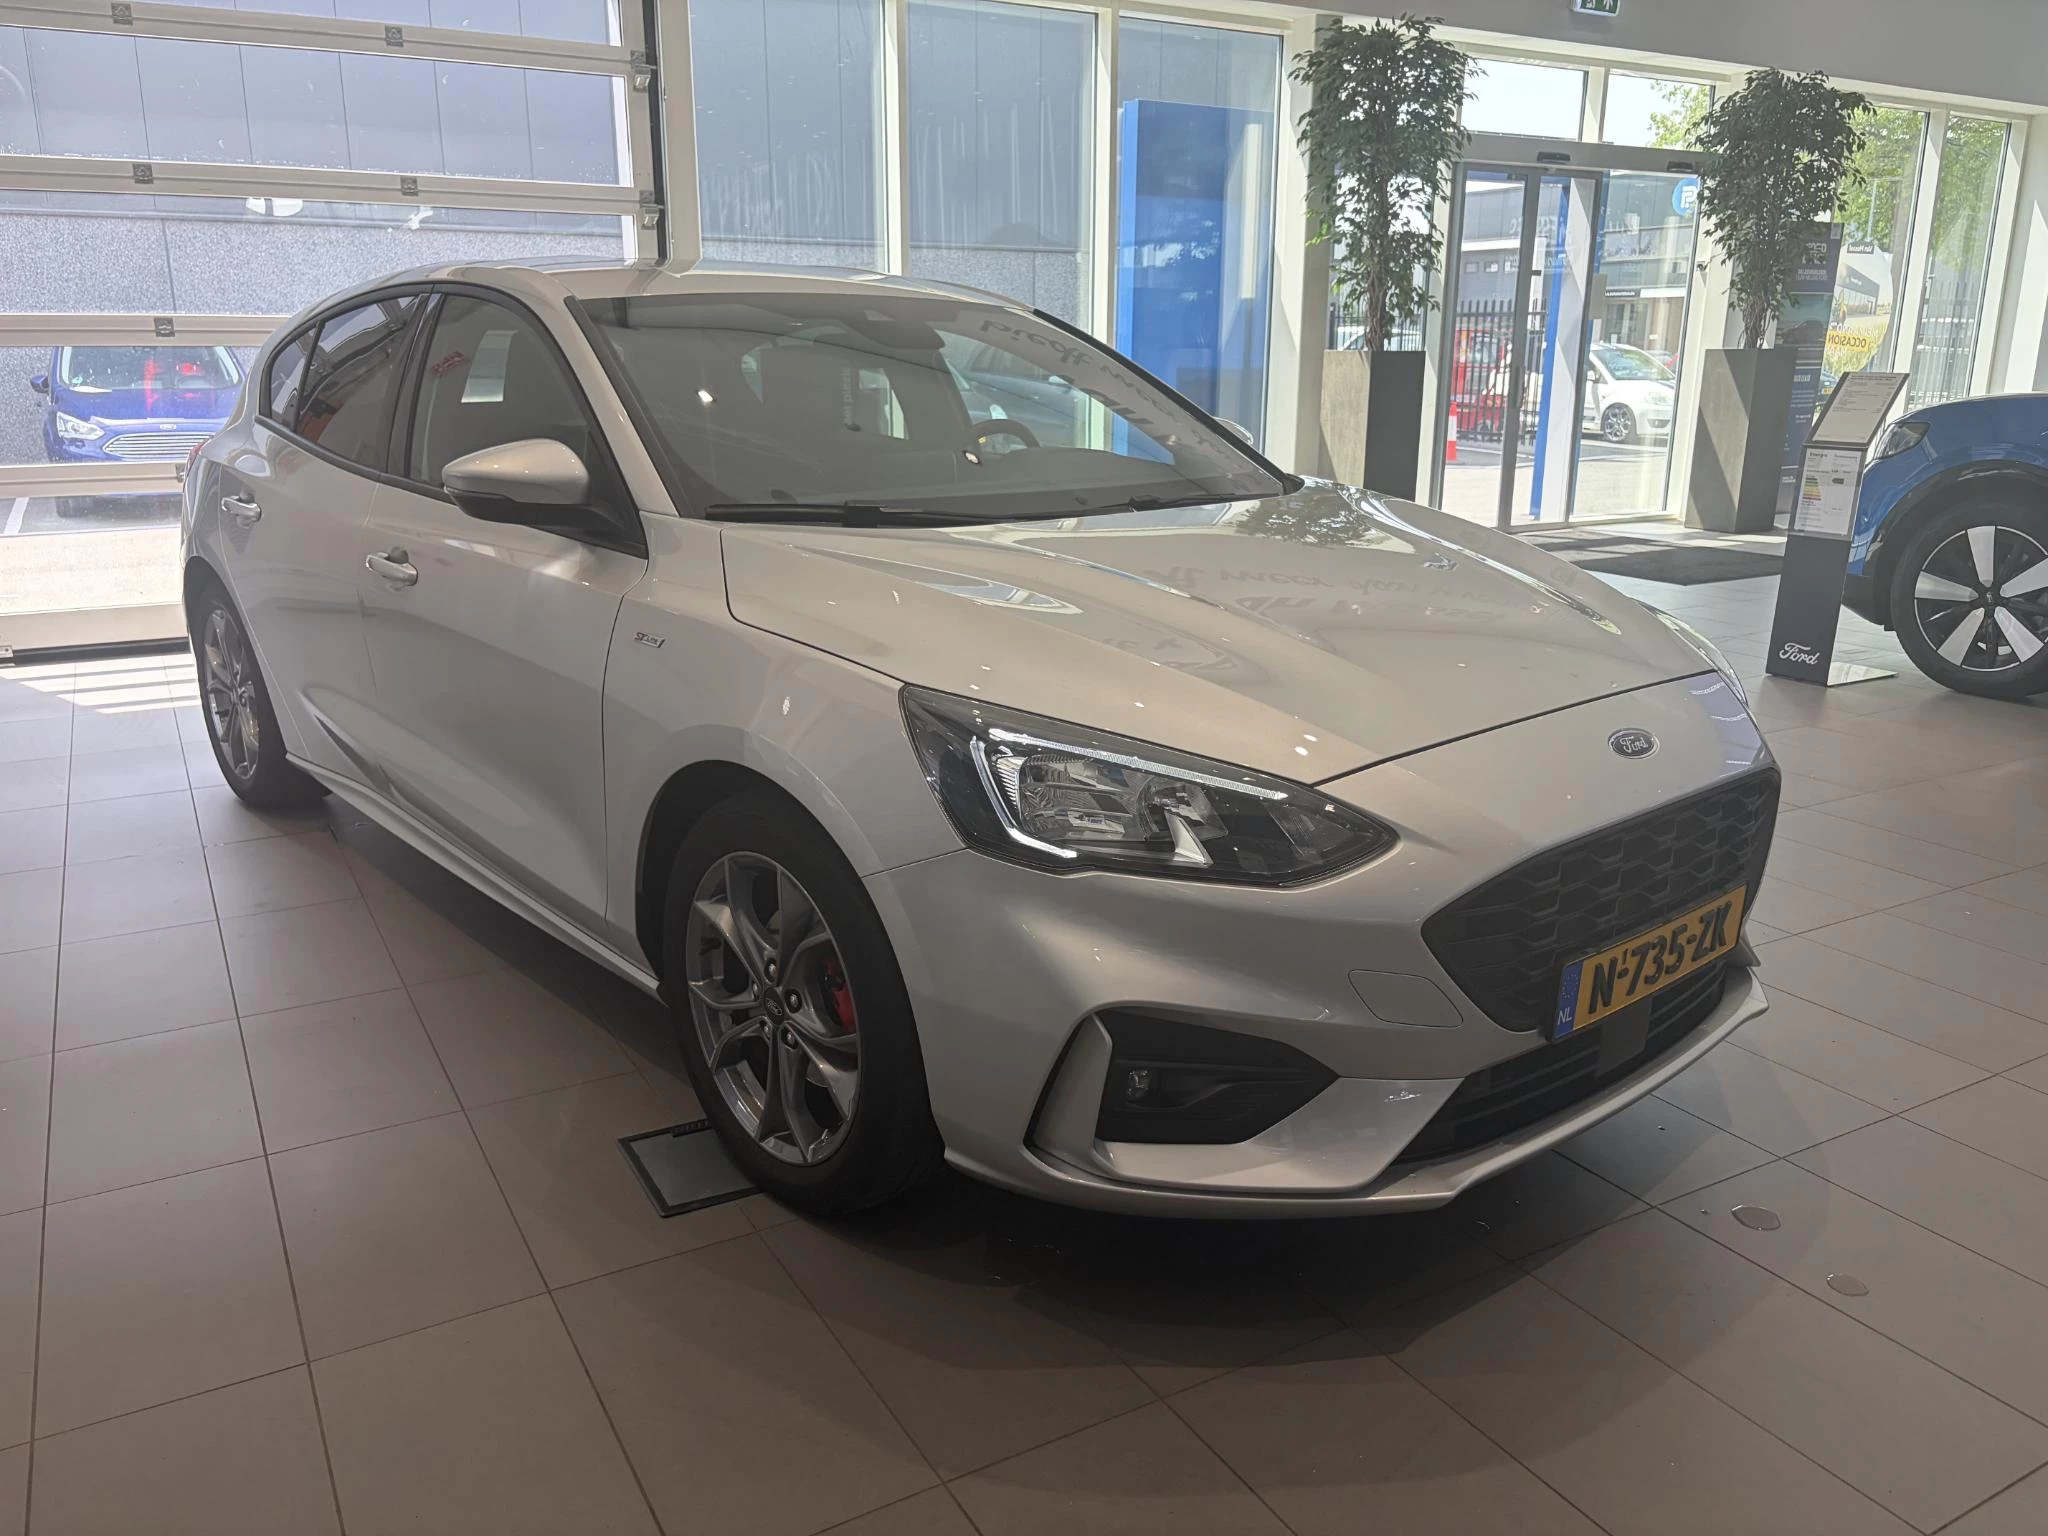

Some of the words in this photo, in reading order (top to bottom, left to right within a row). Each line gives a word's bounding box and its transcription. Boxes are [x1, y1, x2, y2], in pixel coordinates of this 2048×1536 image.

[1779, 642, 1820, 665] Ford
[1620, 735, 1649, 753] Ford
[1557, 1006, 1573, 1025] NL
